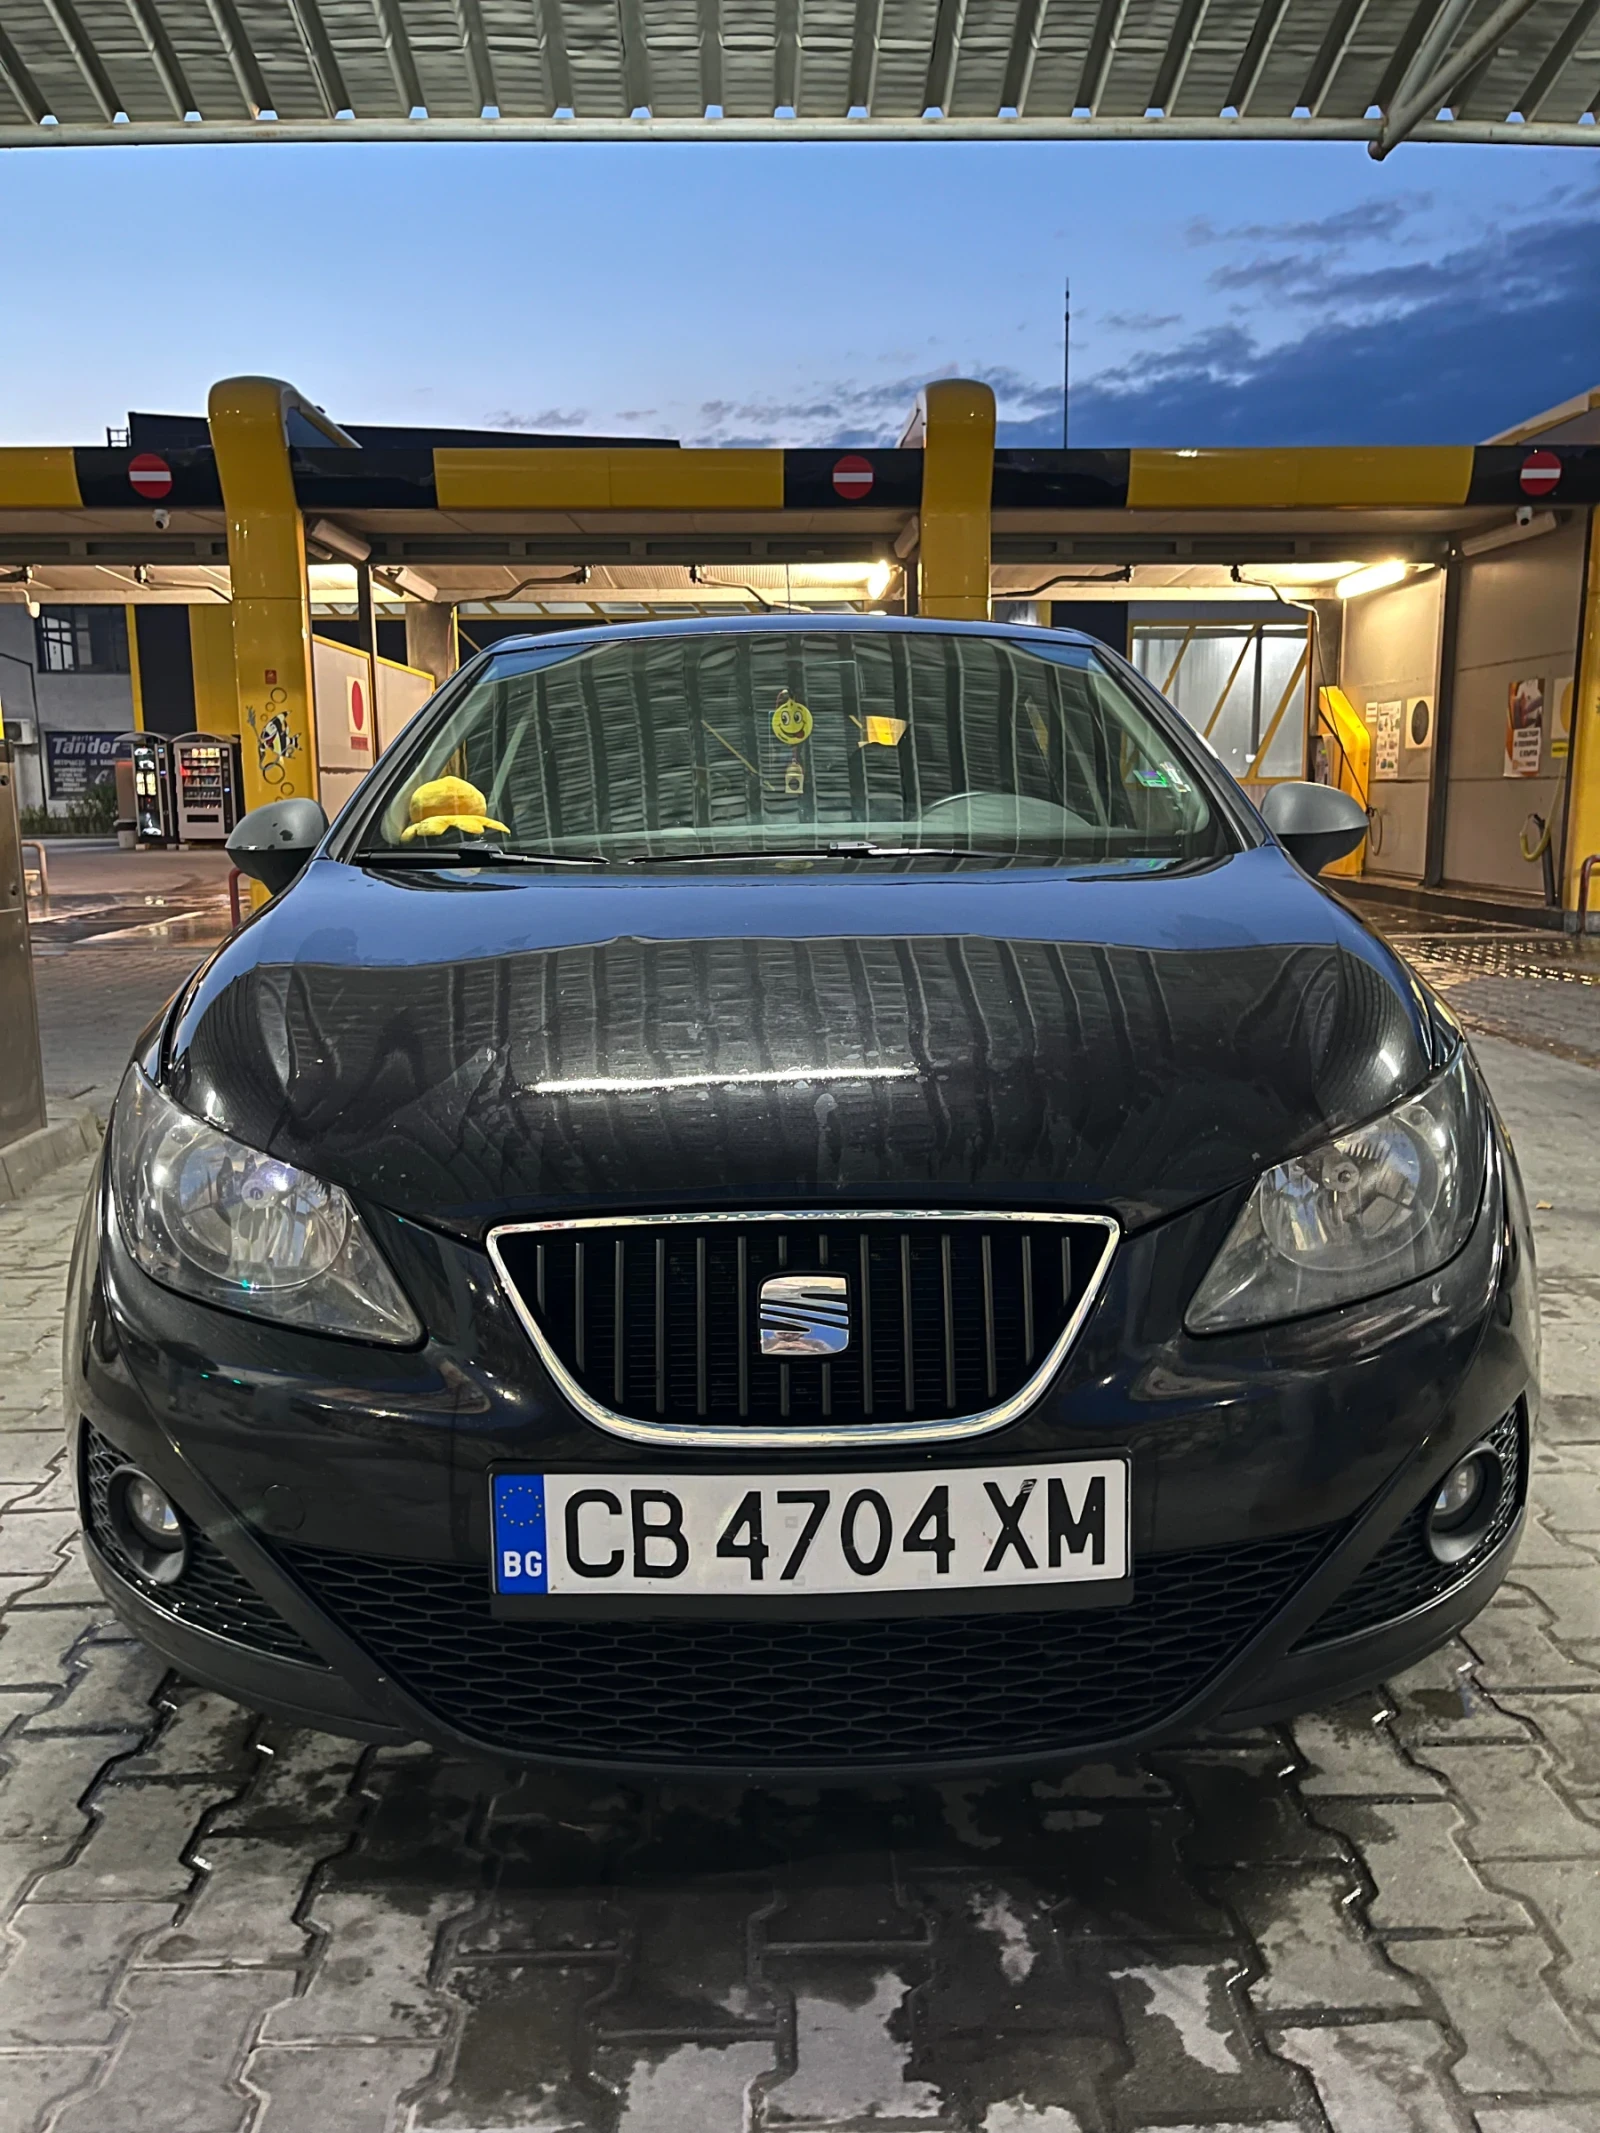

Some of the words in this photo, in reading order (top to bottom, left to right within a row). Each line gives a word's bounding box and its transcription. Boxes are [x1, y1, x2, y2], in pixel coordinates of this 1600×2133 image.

[52, 737, 121, 755] Tander
[565, 1489, 690, 1579] CB
[716, 1484, 956, 1581] 4704
[983, 1476, 1106, 1572] XM
[503, 1550, 543, 1578] BG
